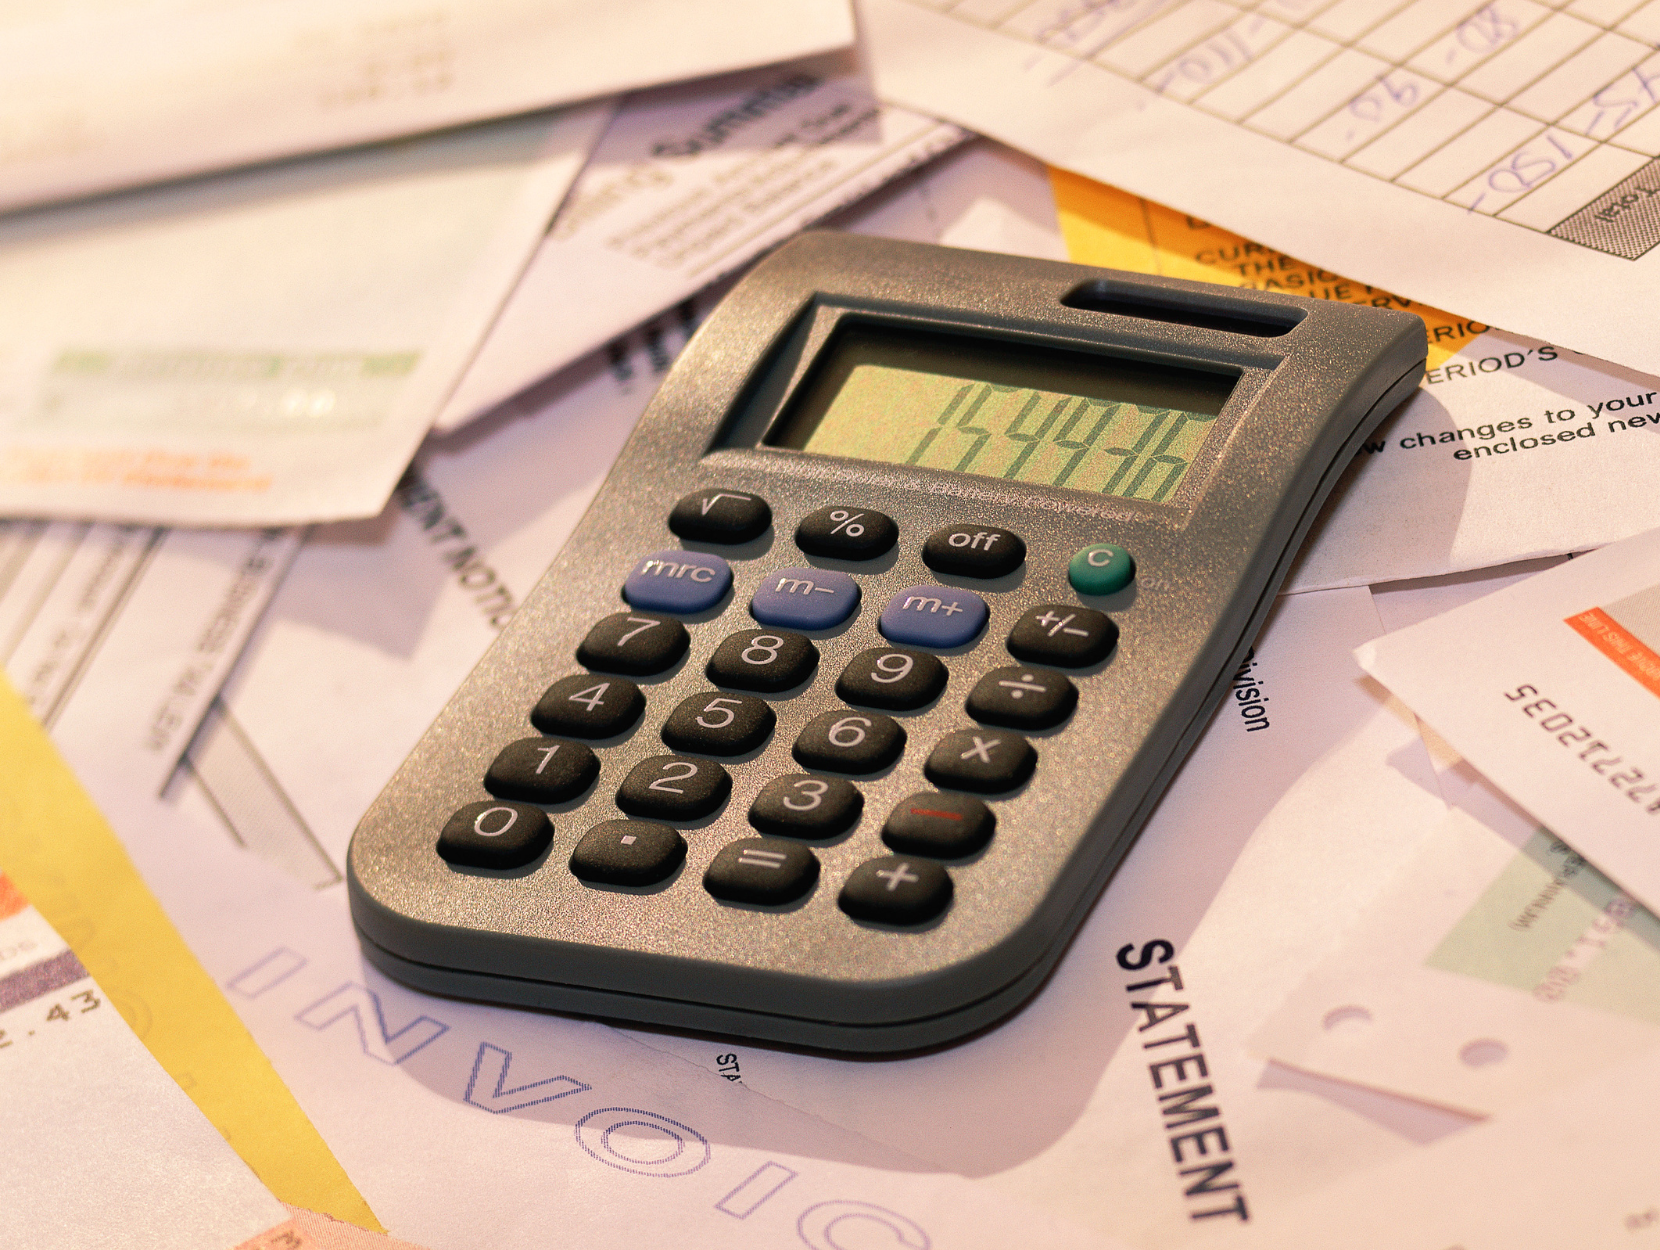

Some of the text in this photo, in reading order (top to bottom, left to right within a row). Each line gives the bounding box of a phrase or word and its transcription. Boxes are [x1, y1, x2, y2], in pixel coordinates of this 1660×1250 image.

[1399, 416, 1533, 450] changes
[1544, 407, 1576, 424] to
[1587, 391, 1658, 419] your
[1453, 422, 1596, 461] enclosed
[1023, 494, 1137, 522] Powered
[948, 531, 1001, 552] off
[641, 559, 717, 583] mrc
[902, 594, 965, 616] m+
[617, 617, 661, 647] 7
[740, 635, 785, 665] 8
[870, 653, 914, 684] 9
[568, 682, 611, 712] 4
[696, 697, 743, 729] 5
[828, 716, 873, 748] 6
[535, 744, 561, 775] 1
[648, 762, 699, 795] 2
[783, 779, 829, 812] 3
[1115, 938, 1252, 1225] STATEMENT
